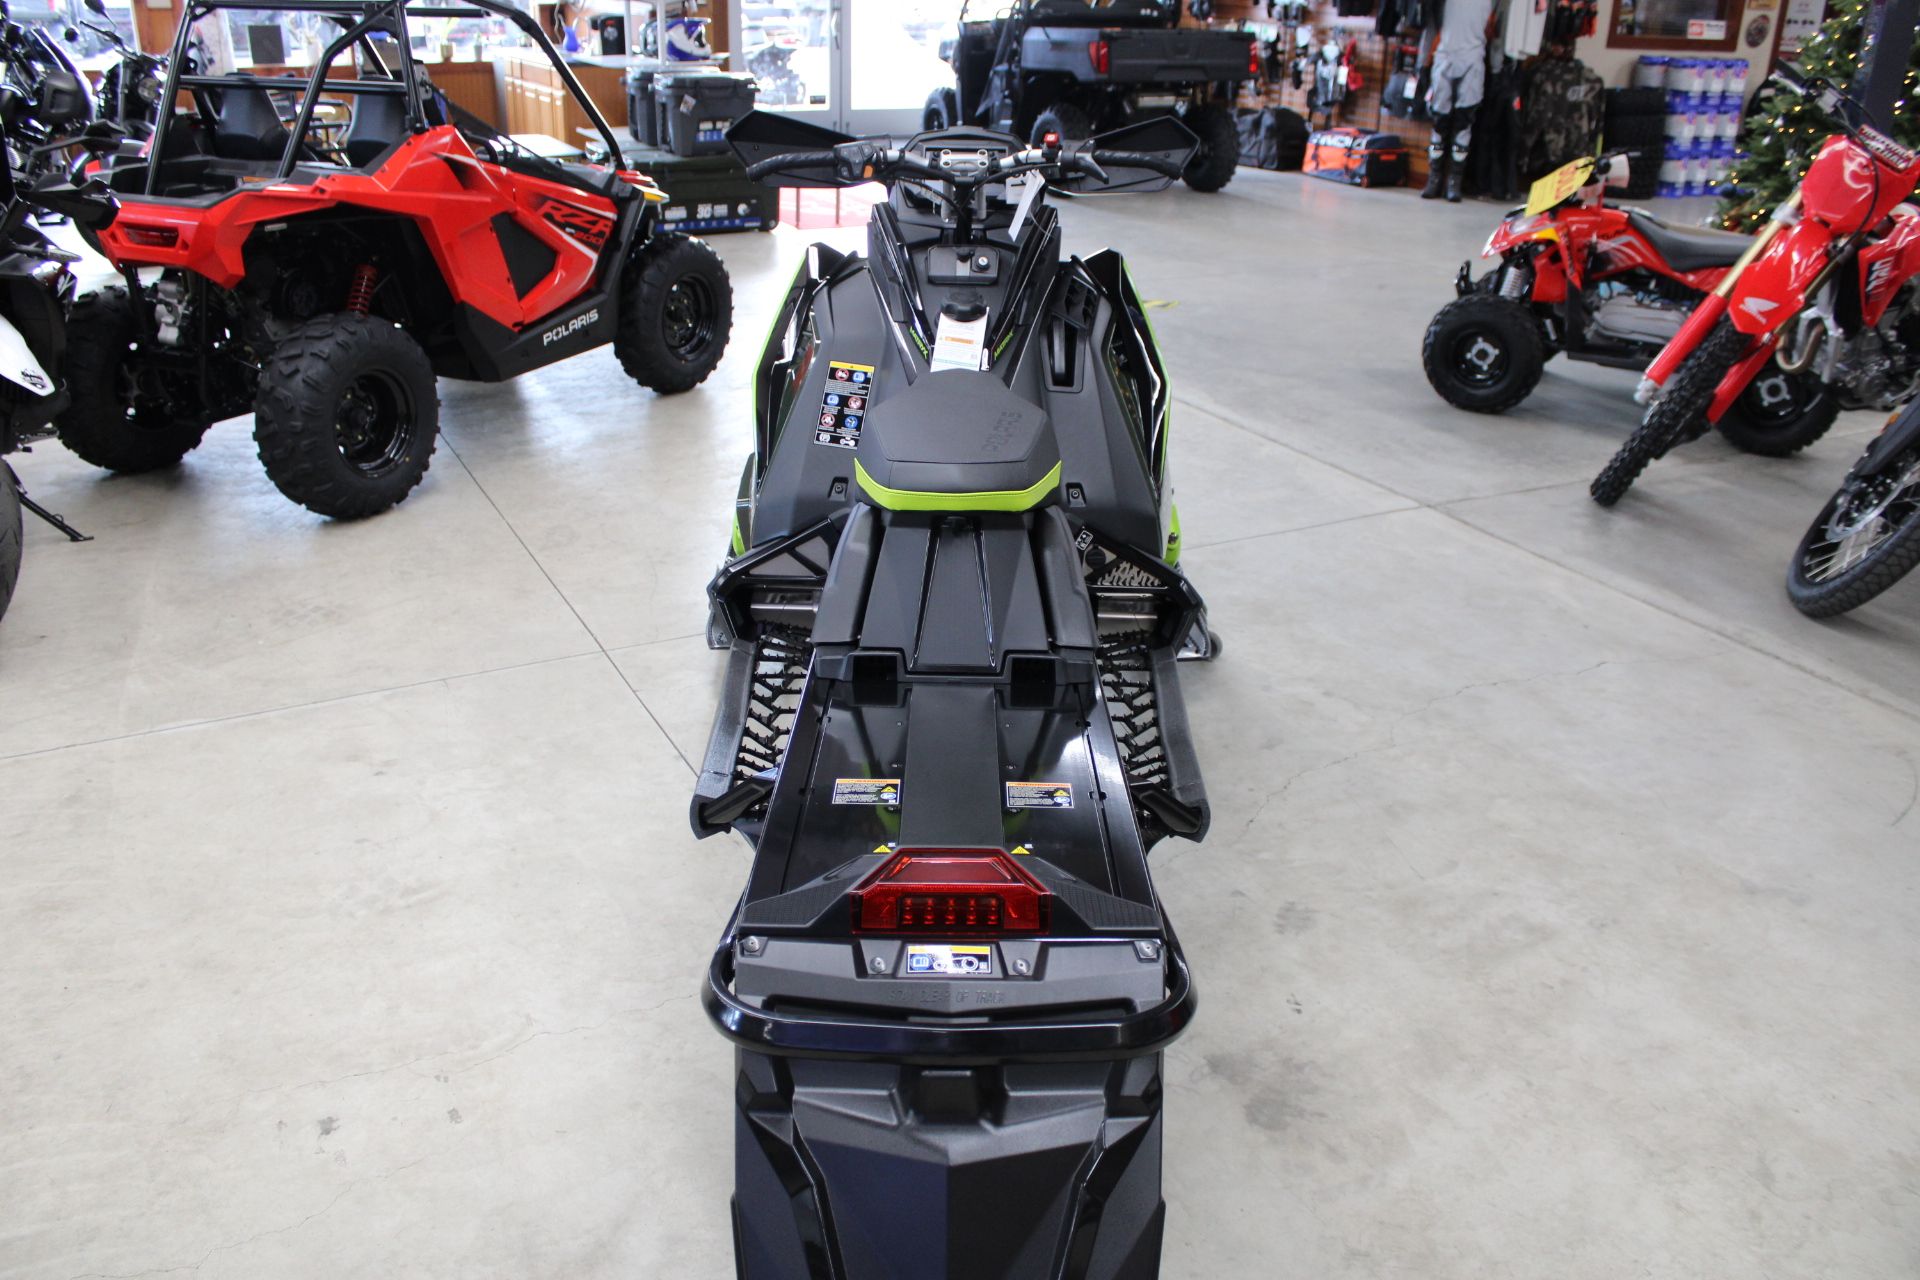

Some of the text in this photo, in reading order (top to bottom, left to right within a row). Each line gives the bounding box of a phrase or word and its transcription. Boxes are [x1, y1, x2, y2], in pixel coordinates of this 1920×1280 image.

[537, 200, 613, 240] RZR
[543, 309, 599, 346] POLARIS
[955, 989, 969, 1003] OF
[975, 989, 1006, 1004] TRACK
